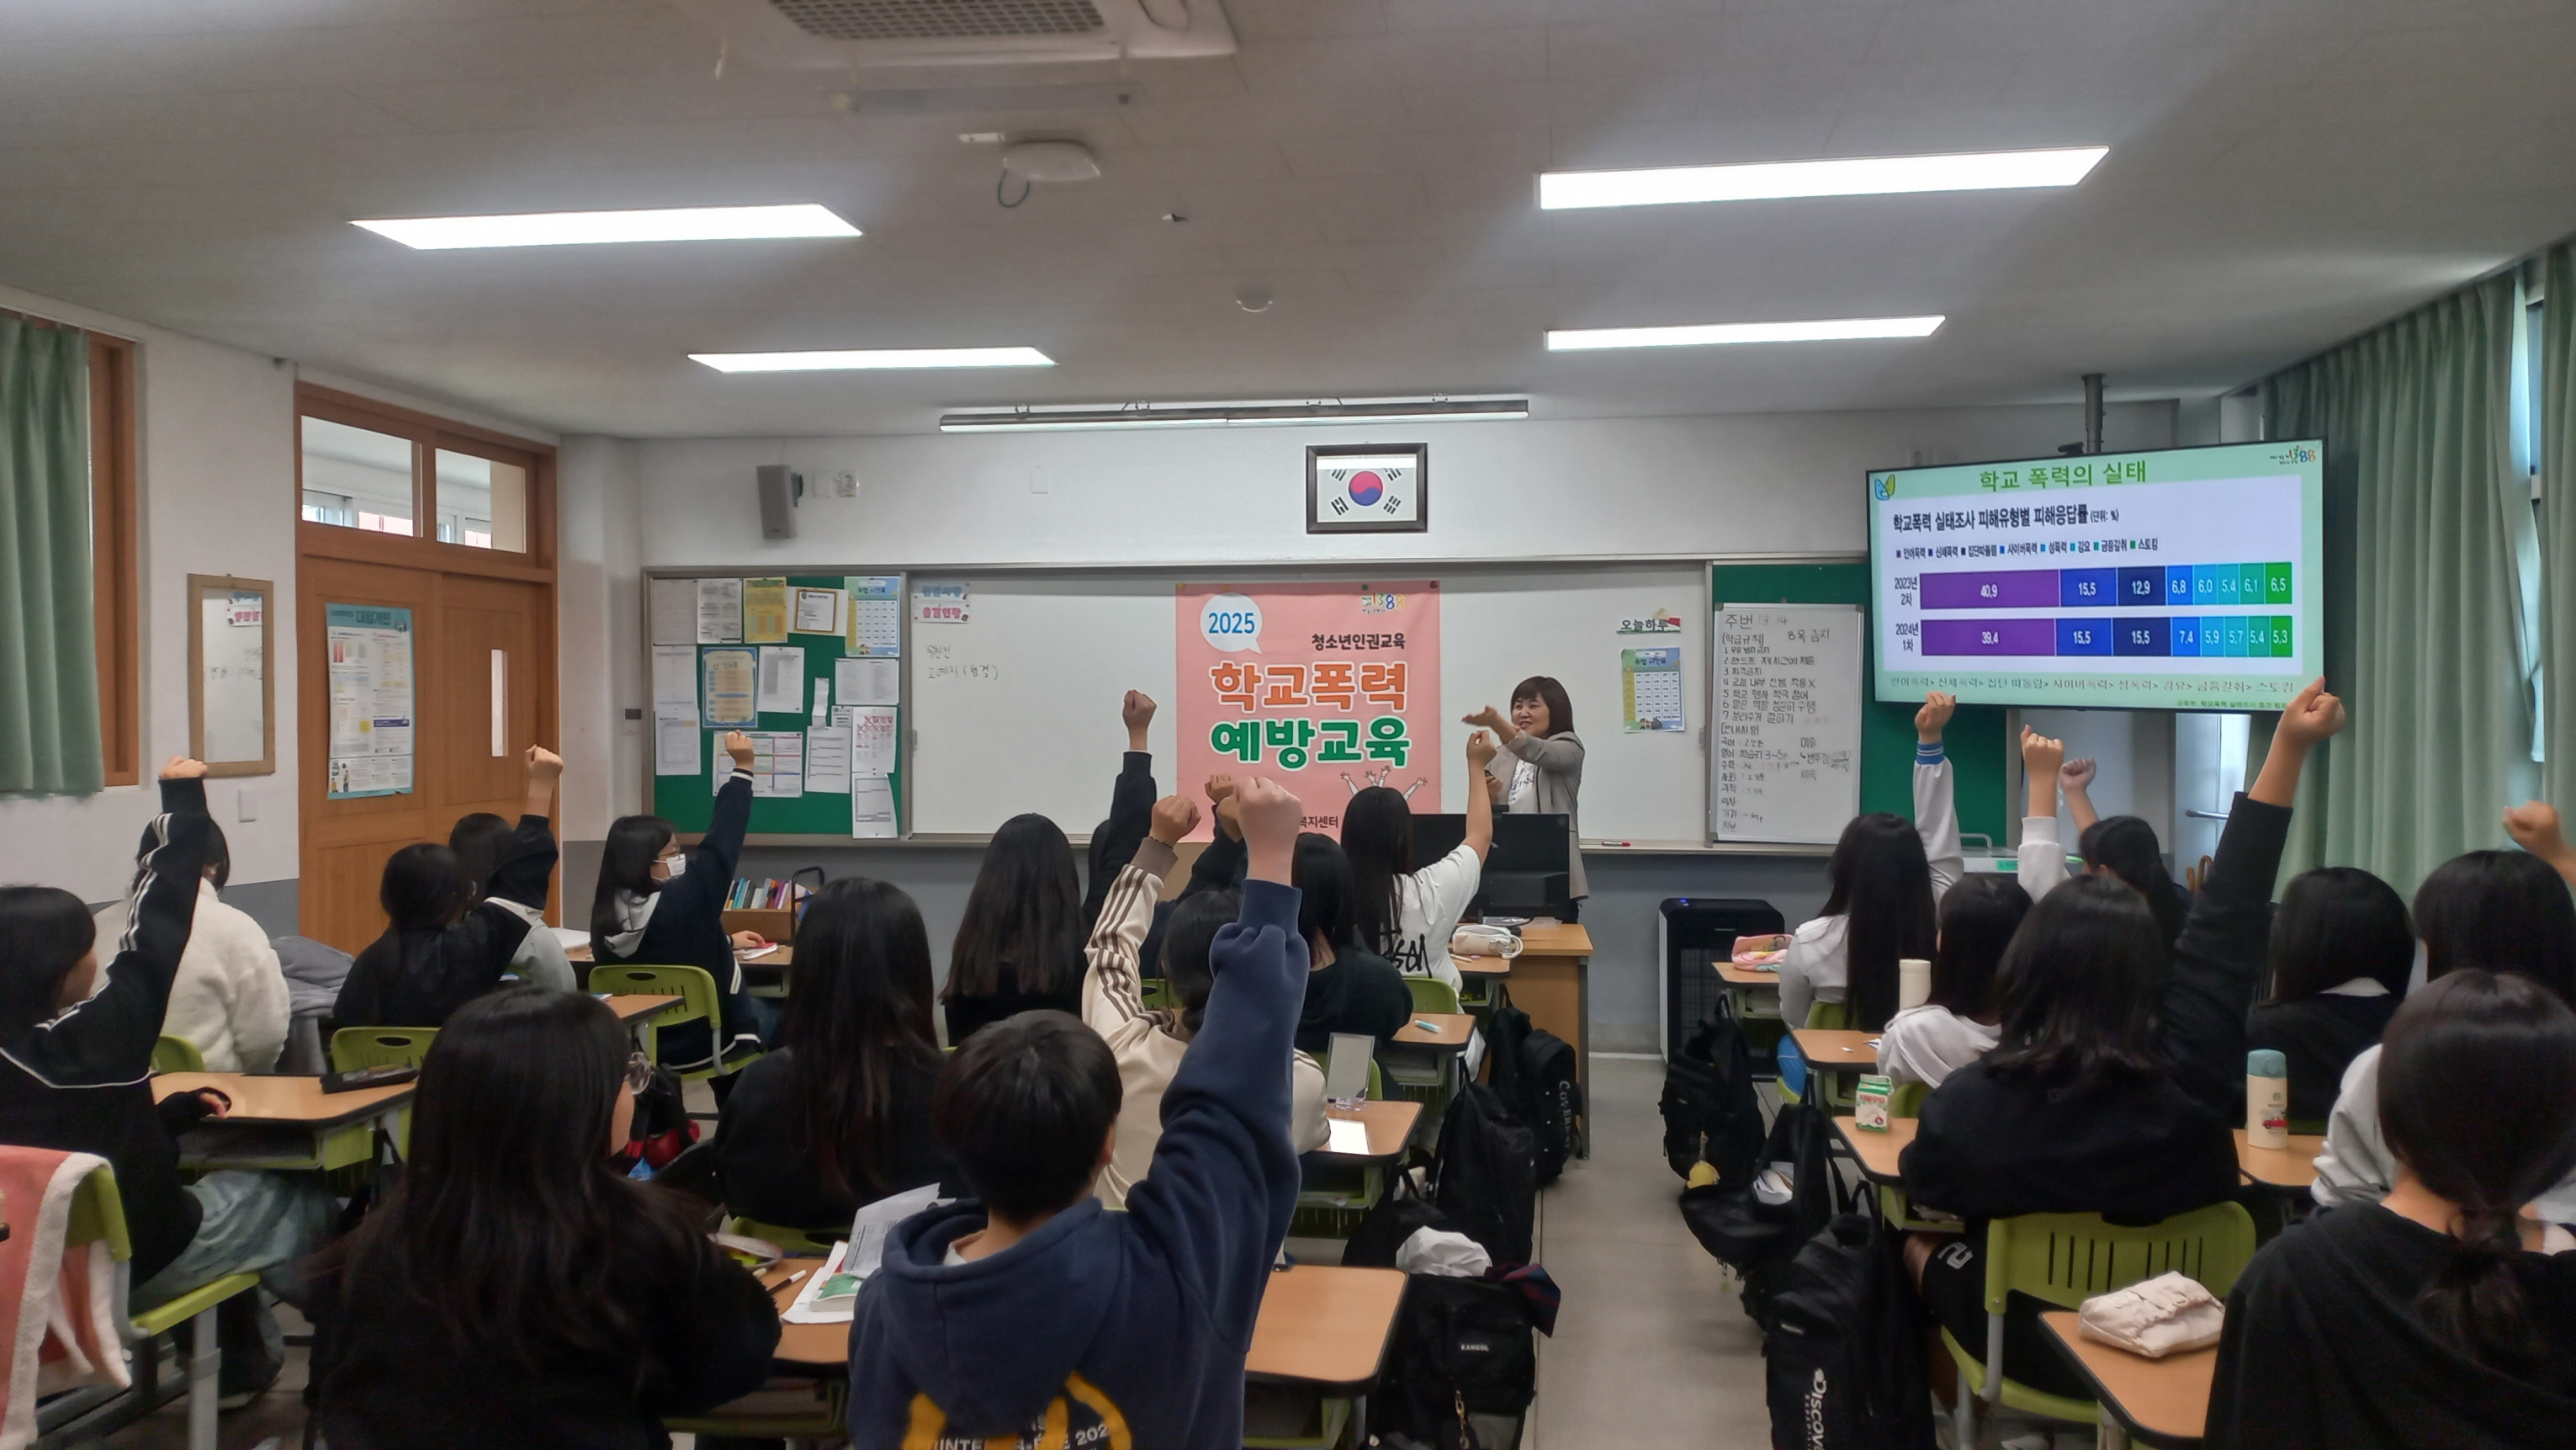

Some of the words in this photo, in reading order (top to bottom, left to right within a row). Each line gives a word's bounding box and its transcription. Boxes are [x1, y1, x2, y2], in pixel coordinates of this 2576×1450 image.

[1980, 470, 2020, 491] 학교
[2028, 464, 2092, 488] 폭력의
[2103, 460, 2146, 485] 실태
[1893, 513, 1932, 533] 학교폭력
[1935, 510, 1975, 531] 실태조사
[1979, 507, 2030, 528] 피해유형별
[2091, 510, 2108, 523] (단위:
[2138, 538, 2158, 550] 스토킹
[1895, 576, 1917, 590] 2023년
[1980, 584, 1998, 598] 40.9
[2079, 582, 2096, 596] 15.5
[2132, 581, 2150, 596] 12.9
[2171, 579, 2186, 594] 6.8
[2197, 579, 2213, 594] 6.0
[2222, 579, 2236, 592] 5.4
[2245, 578, 2258, 592] 6.1
[2271, 577, 2287, 592] 6.5
[1372, 592, 1404, 610] 1388
[1900, 593, 1913, 606] 2차
[1208, 612, 1255, 634] 2025
[1621, 619, 1669, 632] 오늘하루
[1725, 614, 1752, 629] 주번
[1788, 630, 1795, 640] 8
[1810, 629, 1830, 643] 금지
[1895, 622, 1919, 636] 2024년
[1312, 633, 1406, 651] 청소년인권교육
[1982, 631, 1999, 645] 39.4
[2073, 630, 2091, 645] 15.5
[2131, 630, 2150, 645] 15.5
[2180, 630, 2193, 645] 7.4
[2205, 629, 2220, 644] 5.9
[2229, 630, 2244, 644] 5.7
[2250, 629, 2265, 644] 5.4
[2272, 629, 2287, 644] 5.3
[1903, 639, 1914, 652] 1차
[1210, 661, 1407, 712] 학교폭력
[1750, 678, 1765, 687] 내부
[1988, 678, 2007, 689] 집단
[2257, 682, 2293, 693] 스토킹
[1733, 690, 1747, 699] 학교
[1752, 690, 1768, 700] 행사
[1773, 690, 1789, 699] 적극
[1723, 700, 1729, 709] 6
[1798, 701, 1815, 714] 수행
[1723, 710, 1729, 720] 7
[1732, 712, 1762, 722] 분리수거
[1211, 716, 1411, 768] 예방교육
[1721, 737, 1735, 746] 국어
[1721, 748, 1735, 758] 영어
[1739, 749, 1762, 759] 학습지
[1460, 1344, 1489, 1352] KANGOL
[1810, 1378, 1826, 1450] DISCOV
